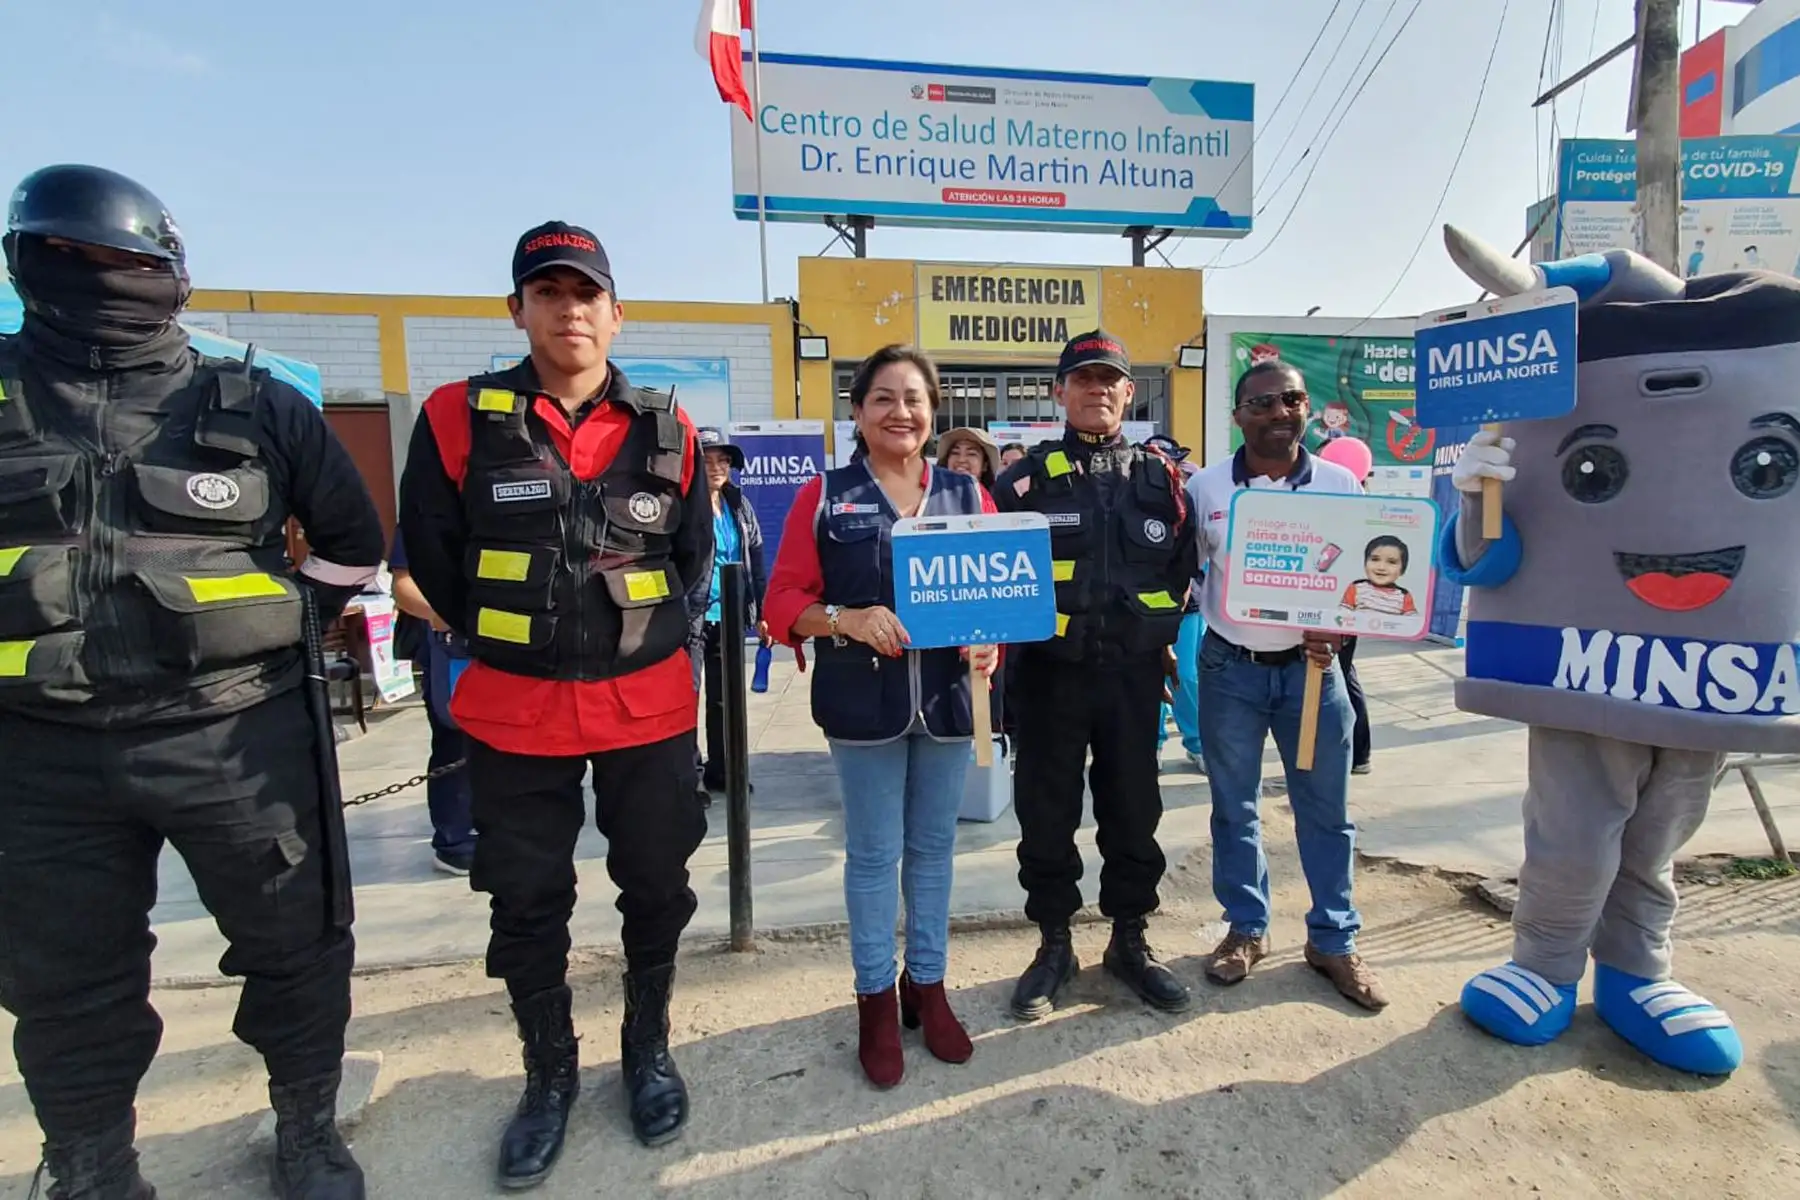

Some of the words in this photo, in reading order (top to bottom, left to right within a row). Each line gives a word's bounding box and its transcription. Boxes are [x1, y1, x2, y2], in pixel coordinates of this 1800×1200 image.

[760, 104, 861, 138] Centro
[872, 110, 908, 141] de
[918, 114, 995, 145] Salud
[1007, 118, 1127, 151] Materno
[1138, 125, 1229, 157] Infantil
[801, 144, 842, 173] Dr.
[856, 147, 976, 184] Enrique
[988, 153, 1088, 184] Martin
[1099, 158, 1194, 189] Altuna
[1577, 151, 1612, 163] Cuida
[1689, 162, 1784, 179] COVID-19
[525, 232, 597, 255] SERENAZGO
[931, 275, 1085, 305] EMERGENCIA
[949, 315, 1069, 342] MEDICINA
[1363, 343, 1408, 358] Hazle
[1428, 329, 1558, 375] MINSA
[1364, 361, 1376, 375] al
[1429, 374, 1463, 390] DIRIS
[1467, 370, 1503, 386] LIMA
[1507, 361, 1559, 381] NORTE
[740, 455, 816, 475] MINSA
[764, 476, 787, 486] LIMA
[1246, 529, 1278, 541] niña
[1281, 533, 1290, 541] o
[1293, 531, 1323, 543] niño
[1246, 542, 1292, 553] contra
[908, 551, 1037, 587] MINSA
[1246, 554, 1286, 569] polio
[1290, 559, 1300, 572] y
[911, 588, 948, 604] DIRIS
[951, 586, 988, 601] LIMA
[991, 584, 1040, 599] NORTE
[1552, 626, 1800, 714] MINSA
